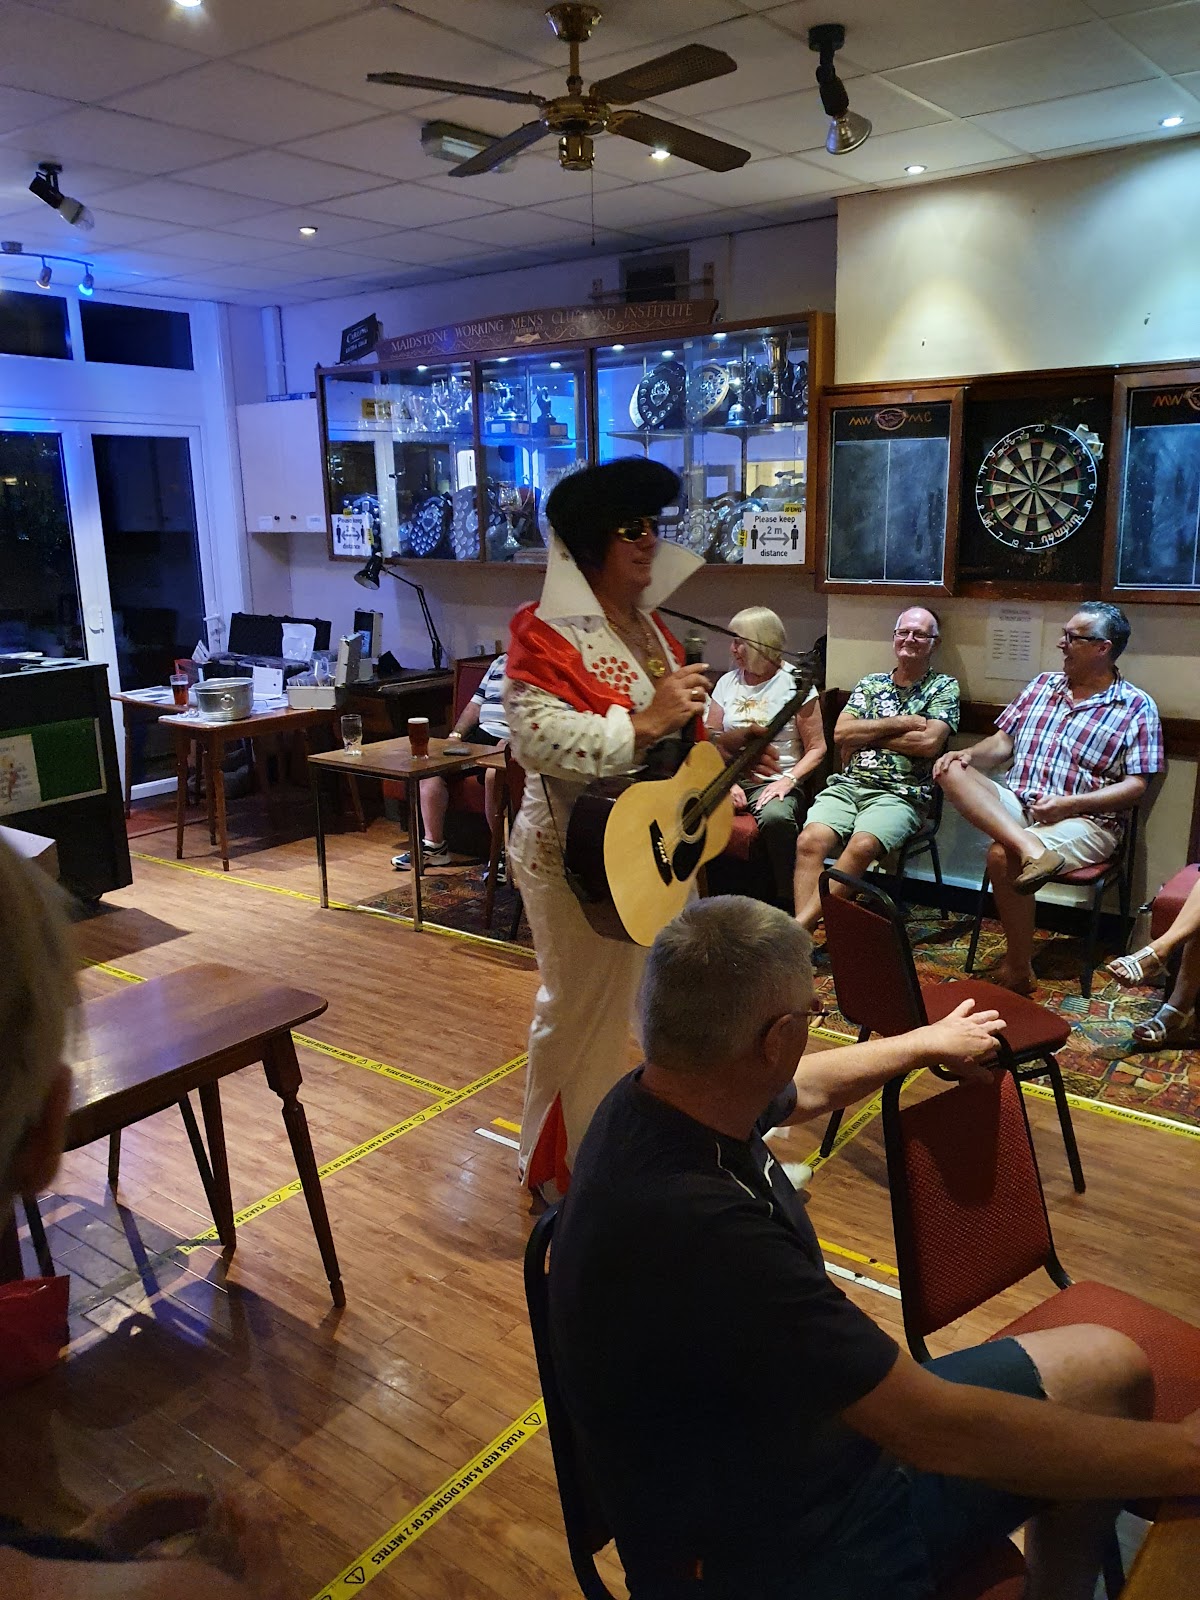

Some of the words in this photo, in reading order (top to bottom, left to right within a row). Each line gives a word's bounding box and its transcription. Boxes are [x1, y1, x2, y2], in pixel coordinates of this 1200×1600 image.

[391, 329, 449, 352] MAIDSTONE
[454, 319, 505, 339] WORKING
[551, 309, 583, 325] CLU
[624, 302, 694, 320] INSTITUTE
[754, 515, 778, 523] Please
[779, 515, 796, 524] keep
[766, 525, 772, 535] 2
[774, 527, 783, 535] m
[760, 549, 788, 557] distance
[1109, 1109, 1134, 1120] PLEASE
[1133, 1114, 1152, 1124] KEEP
[1157, 1122, 1175, 1131] SAFE
[382, 1132, 395, 1141] KEEP
[393, 1122, 414, 1136] PLEASE
[365, 1141, 379, 1151] SAFE
[341, 1148, 366, 1165] DISTANCE
[243, 1203, 267, 1218] PLEASE
[182, 1232, 216, 1252] DISTANCE
[496, 1429, 526, 1455] PLEASE
[481, 1449, 503, 1470] KEEP
[475, 1466, 485, 1475] A
[459, 1470, 479, 1491] SAFE
[424, 1486, 461, 1522] DISTANCE
[402, 1526, 413, 1537] 2
[410, 1517, 425, 1532] OF
[370, 1531, 408, 1566] METRES
